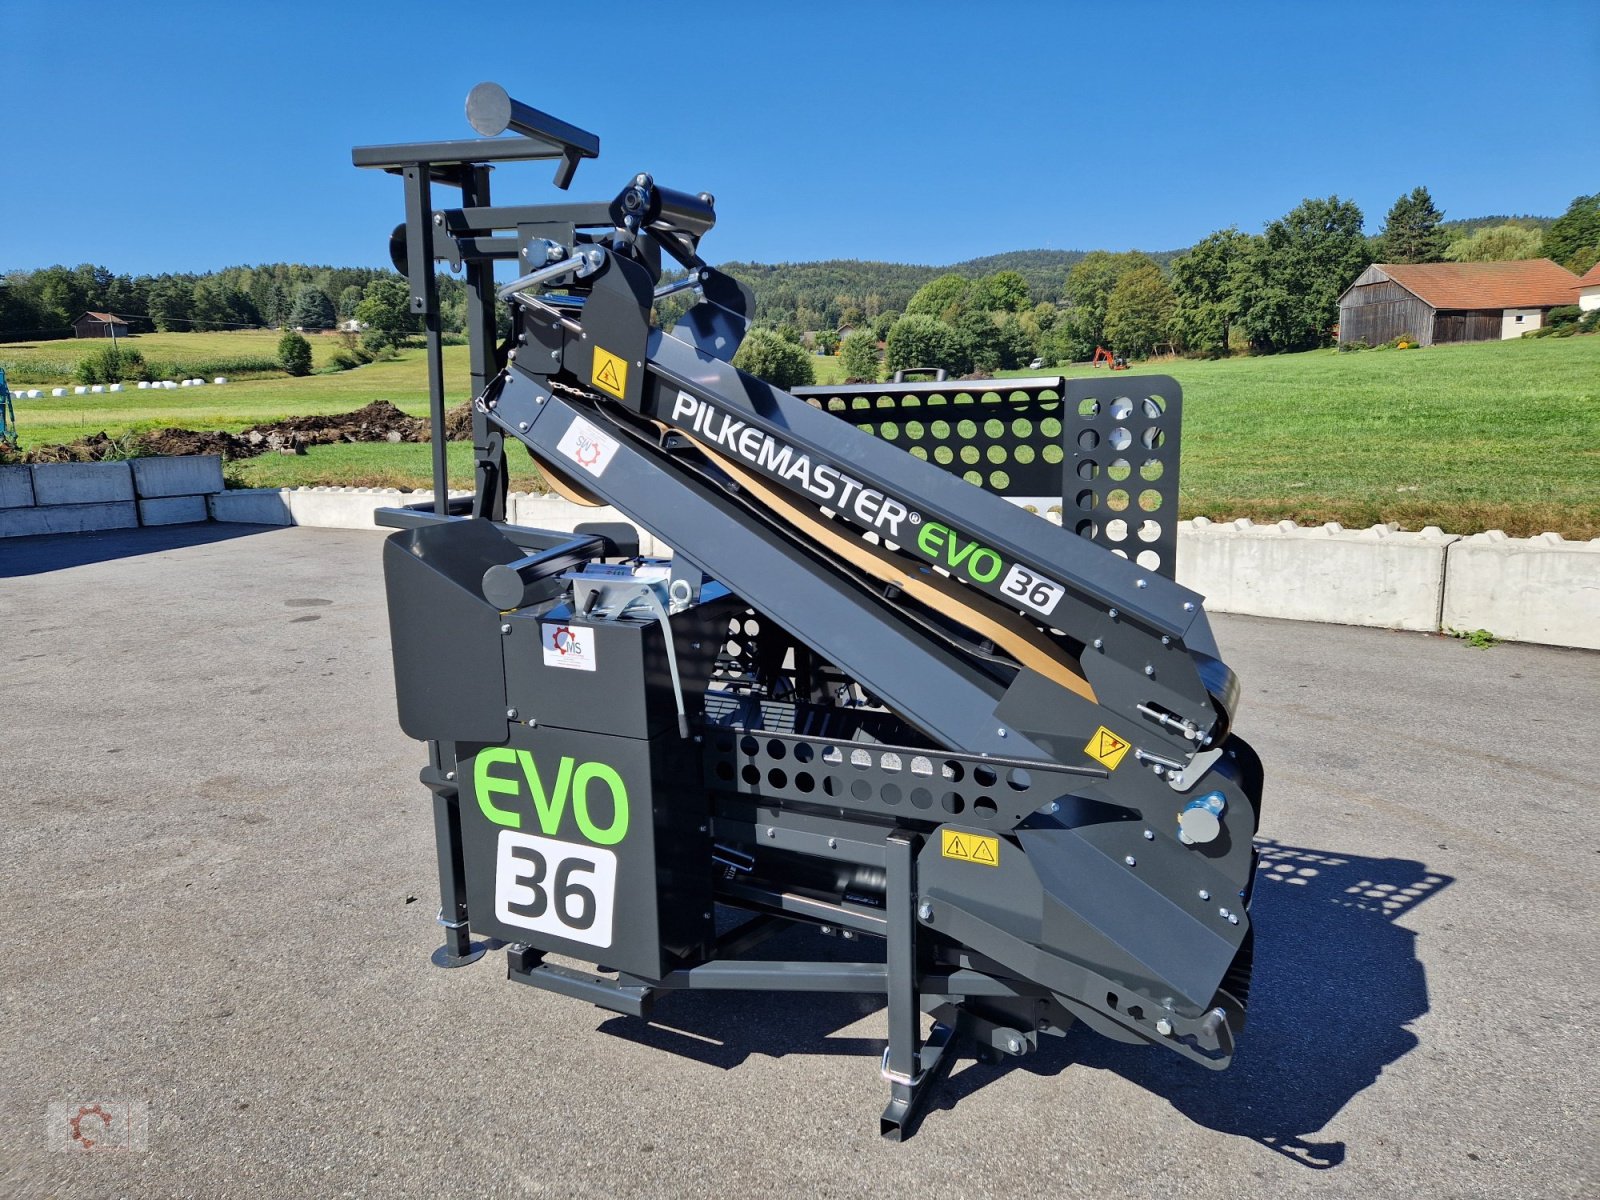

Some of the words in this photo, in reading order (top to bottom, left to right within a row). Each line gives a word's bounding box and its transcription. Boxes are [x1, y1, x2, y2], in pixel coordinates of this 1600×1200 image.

[917, 521, 1003, 583] EVO
[1006, 569, 1056, 608] 36
[474, 746, 629, 845] EVO
[507, 845, 597, 931] 36
